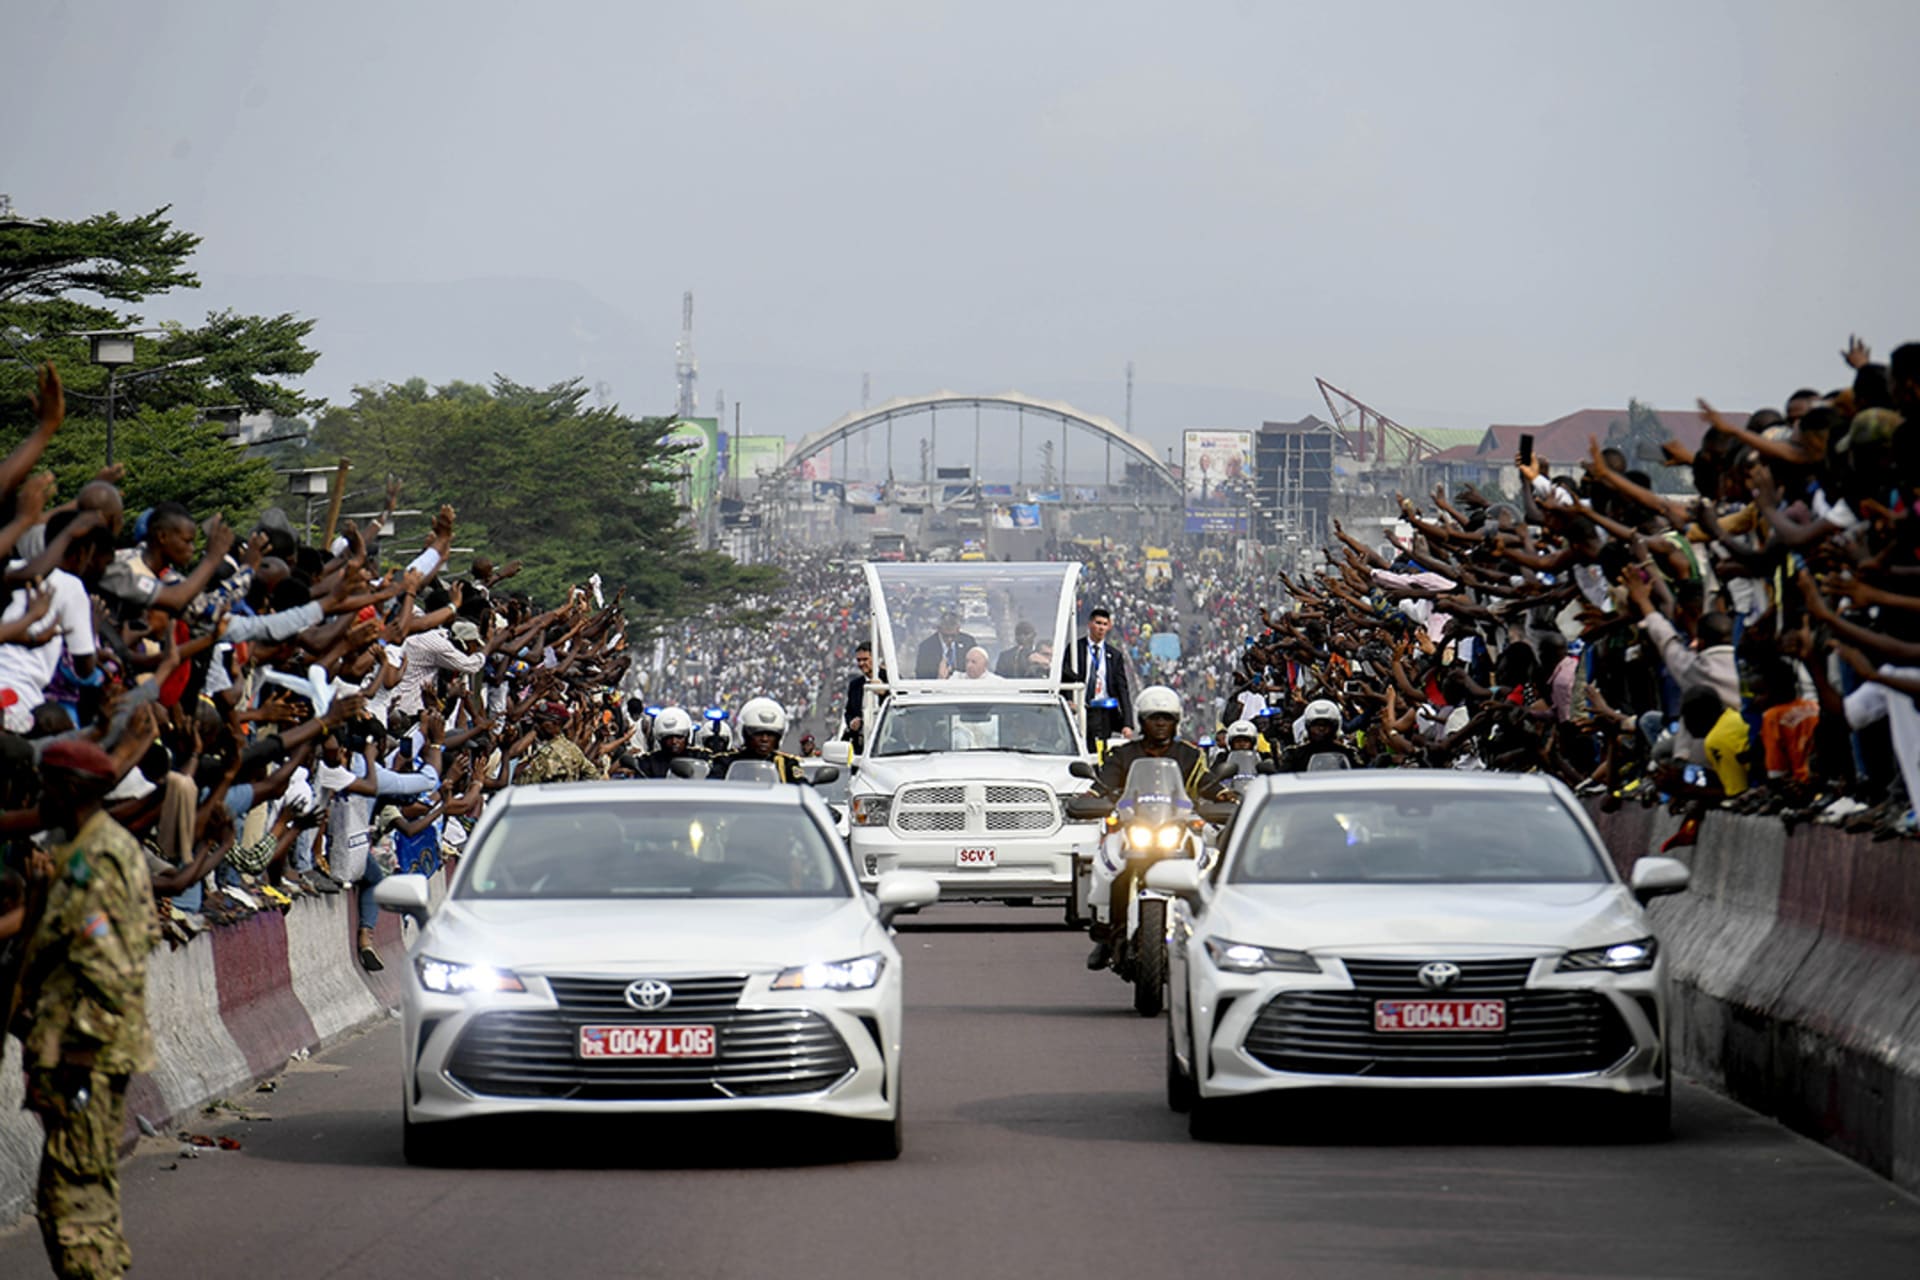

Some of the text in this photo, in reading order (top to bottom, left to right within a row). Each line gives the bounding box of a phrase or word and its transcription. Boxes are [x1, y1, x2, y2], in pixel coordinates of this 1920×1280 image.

[960, 849, 995, 862] SCV 1
[1402, 1004, 1454, 1027] 0044
[608, 1029, 662, 1053] 0047
